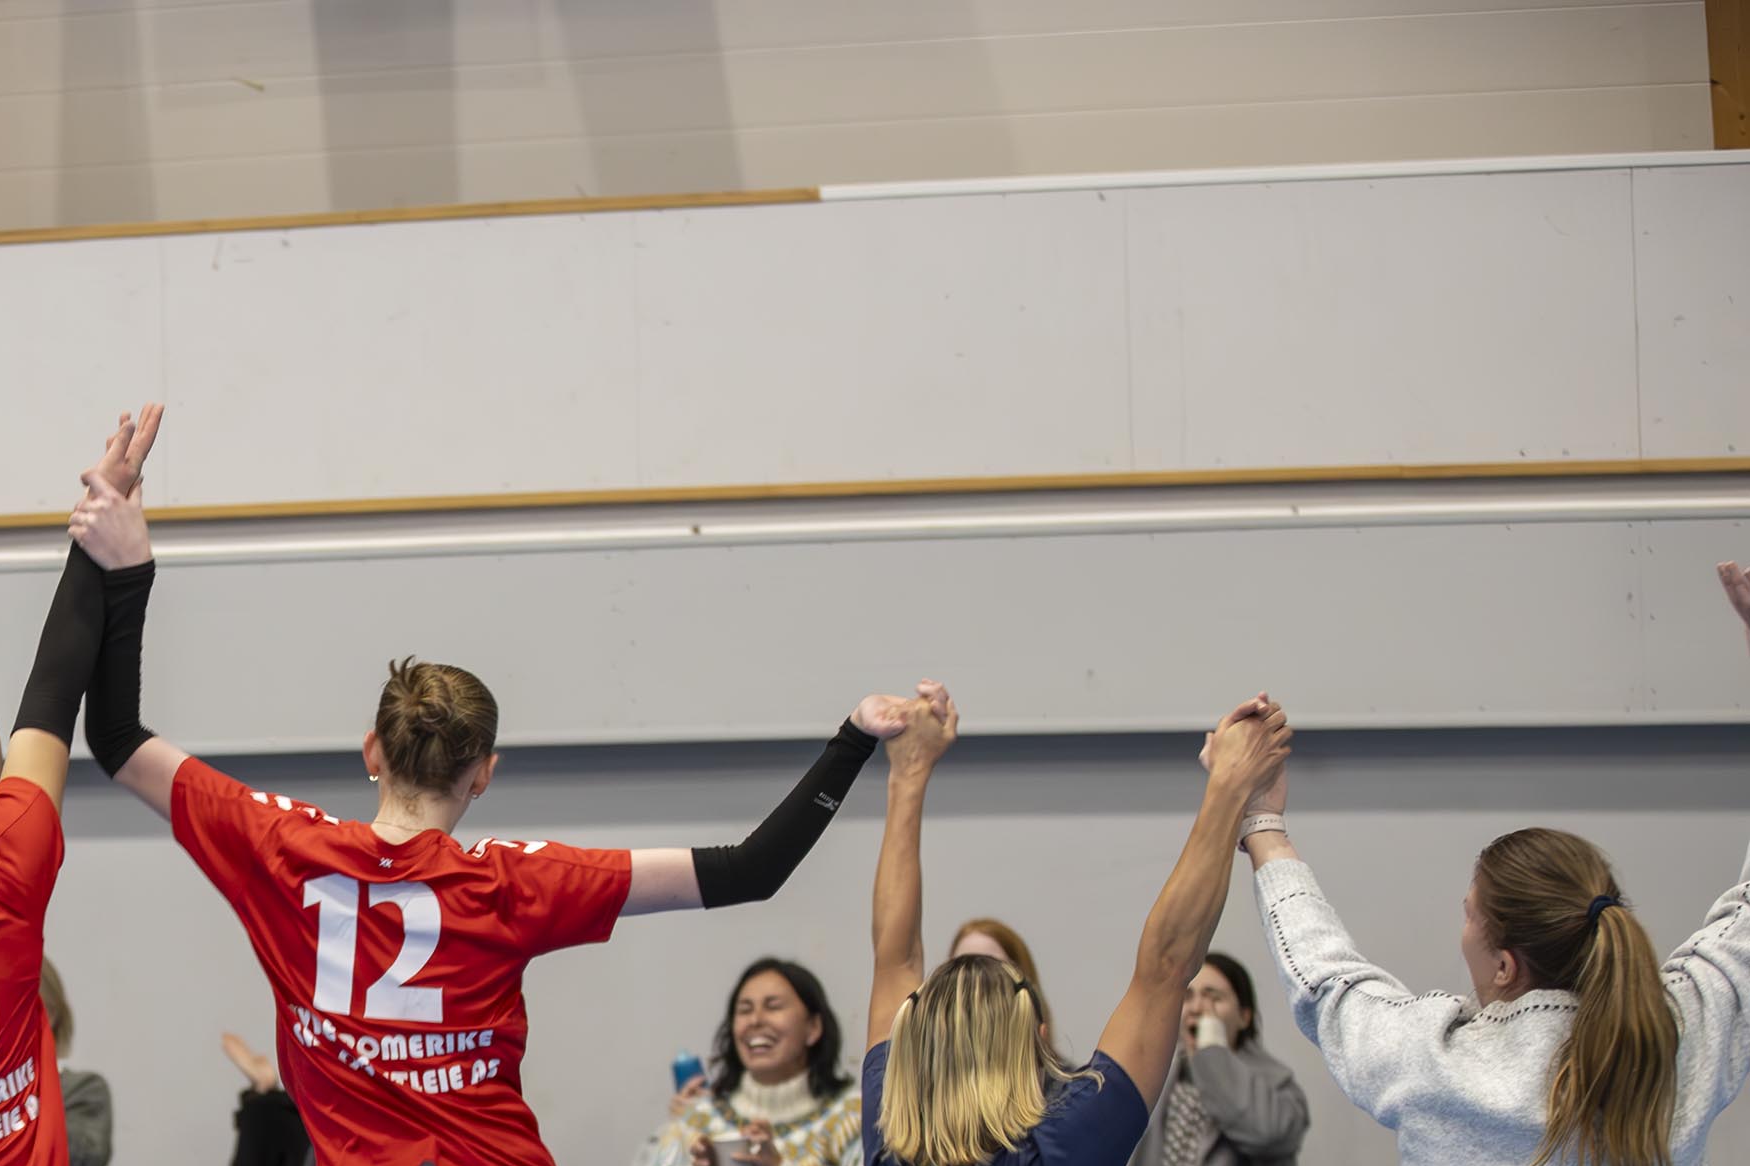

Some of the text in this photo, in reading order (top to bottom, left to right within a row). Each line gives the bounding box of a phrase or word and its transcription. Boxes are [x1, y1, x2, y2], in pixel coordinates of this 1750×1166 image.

[303, 873, 444, 1023] 12
[382, 1058, 500, 1094] TLEIE AS
